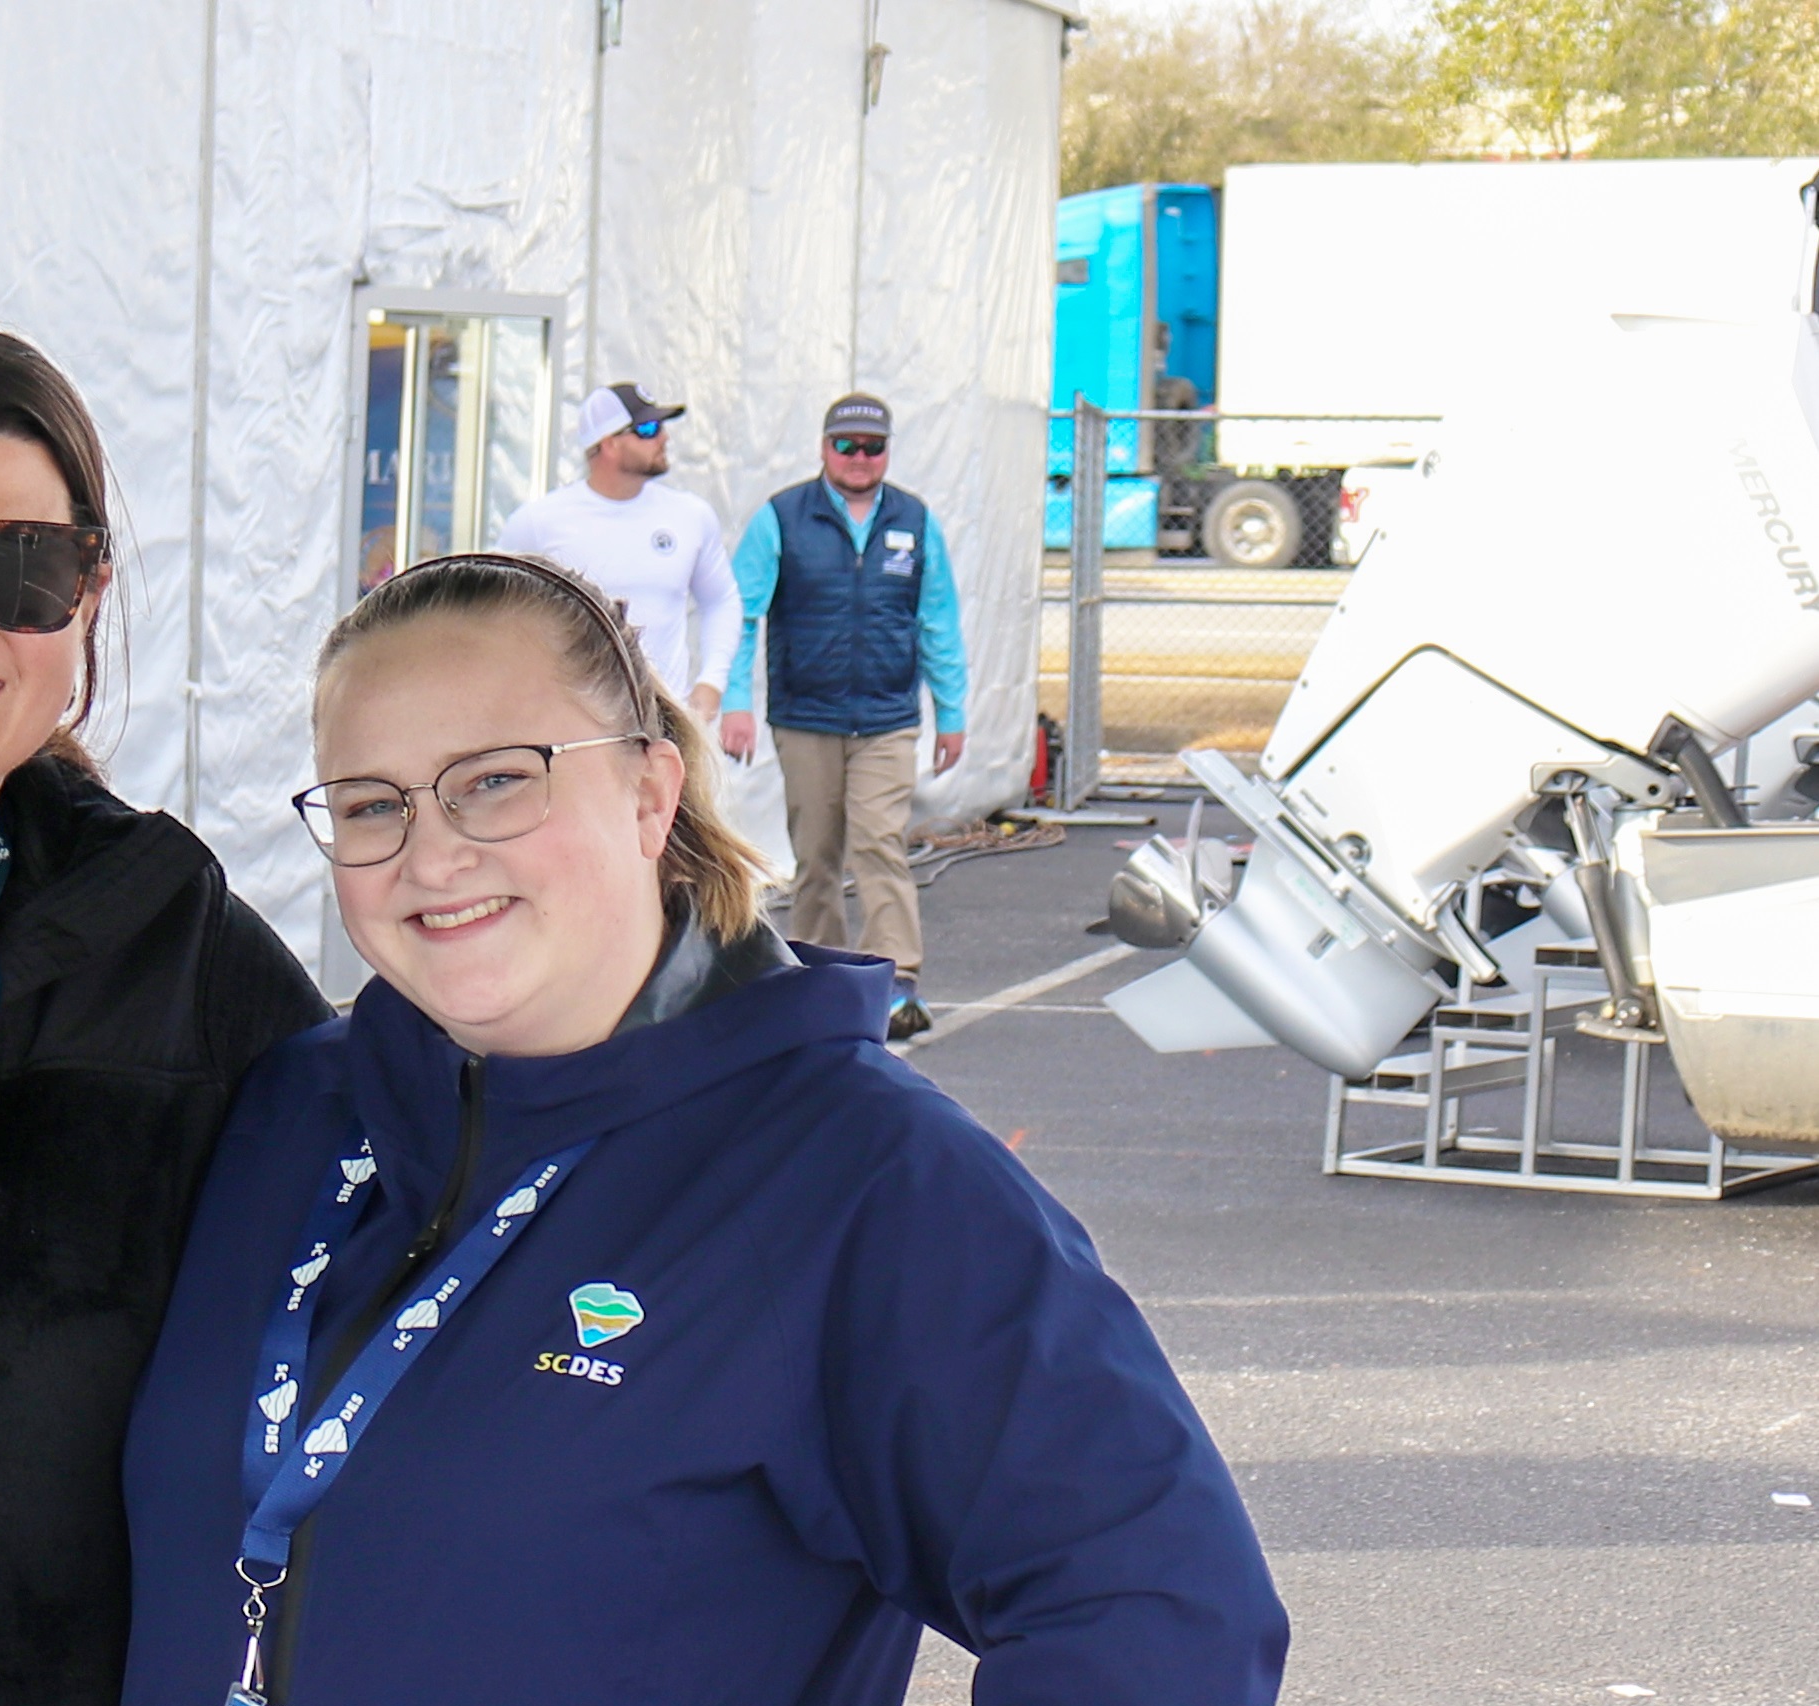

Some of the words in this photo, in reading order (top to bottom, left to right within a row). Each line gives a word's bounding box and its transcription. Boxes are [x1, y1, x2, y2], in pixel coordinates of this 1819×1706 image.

[533, 1163, 560, 1189] DES
[335, 1181, 357, 1204] DES
[491, 1218, 513, 1237] SC
[286, 1286, 306, 1312] DES
[434, 1275, 462, 1303] DES
[392, 1330, 414, 1352] SC
[274, 1362, 290, 1382] SC
[533, 1350, 626, 1388] SCDES
[339, 1392, 366, 1423] DES
[264, 1423, 280, 1454] DES
[303, 1455, 325, 1479] SC
